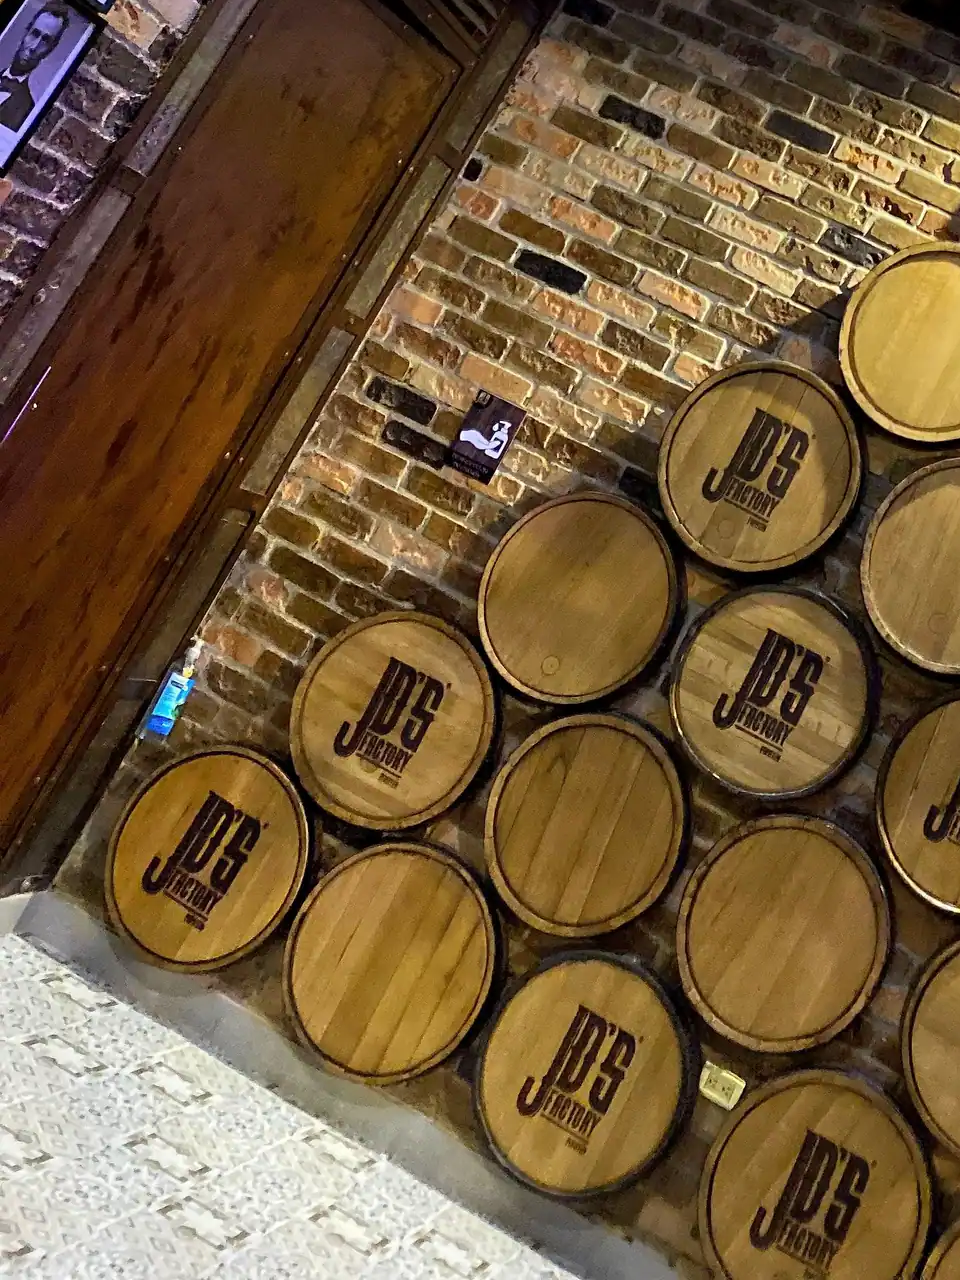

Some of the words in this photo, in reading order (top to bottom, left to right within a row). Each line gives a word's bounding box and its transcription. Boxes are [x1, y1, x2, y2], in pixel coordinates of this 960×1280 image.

[702, 407, 809, 503] JD'S
[726, 479, 780, 518] FACTORY
[334, 657, 445, 758] JD'S
[712, 628, 823, 730] JD'S
[360, 731, 413, 772] FACTORY
[738, 703, 793, 747] FACTORY
[142, 790, 261, 894] JD'S
[166, 870, 223, 914] FACTORY
[517, 1004, 636, 1116] JD'S
[543, 1088, 601, 1138] FACTORY
[750, 1129, 870, 1250] JD'S
[776, 1220, 839, 1269] FACTORY
